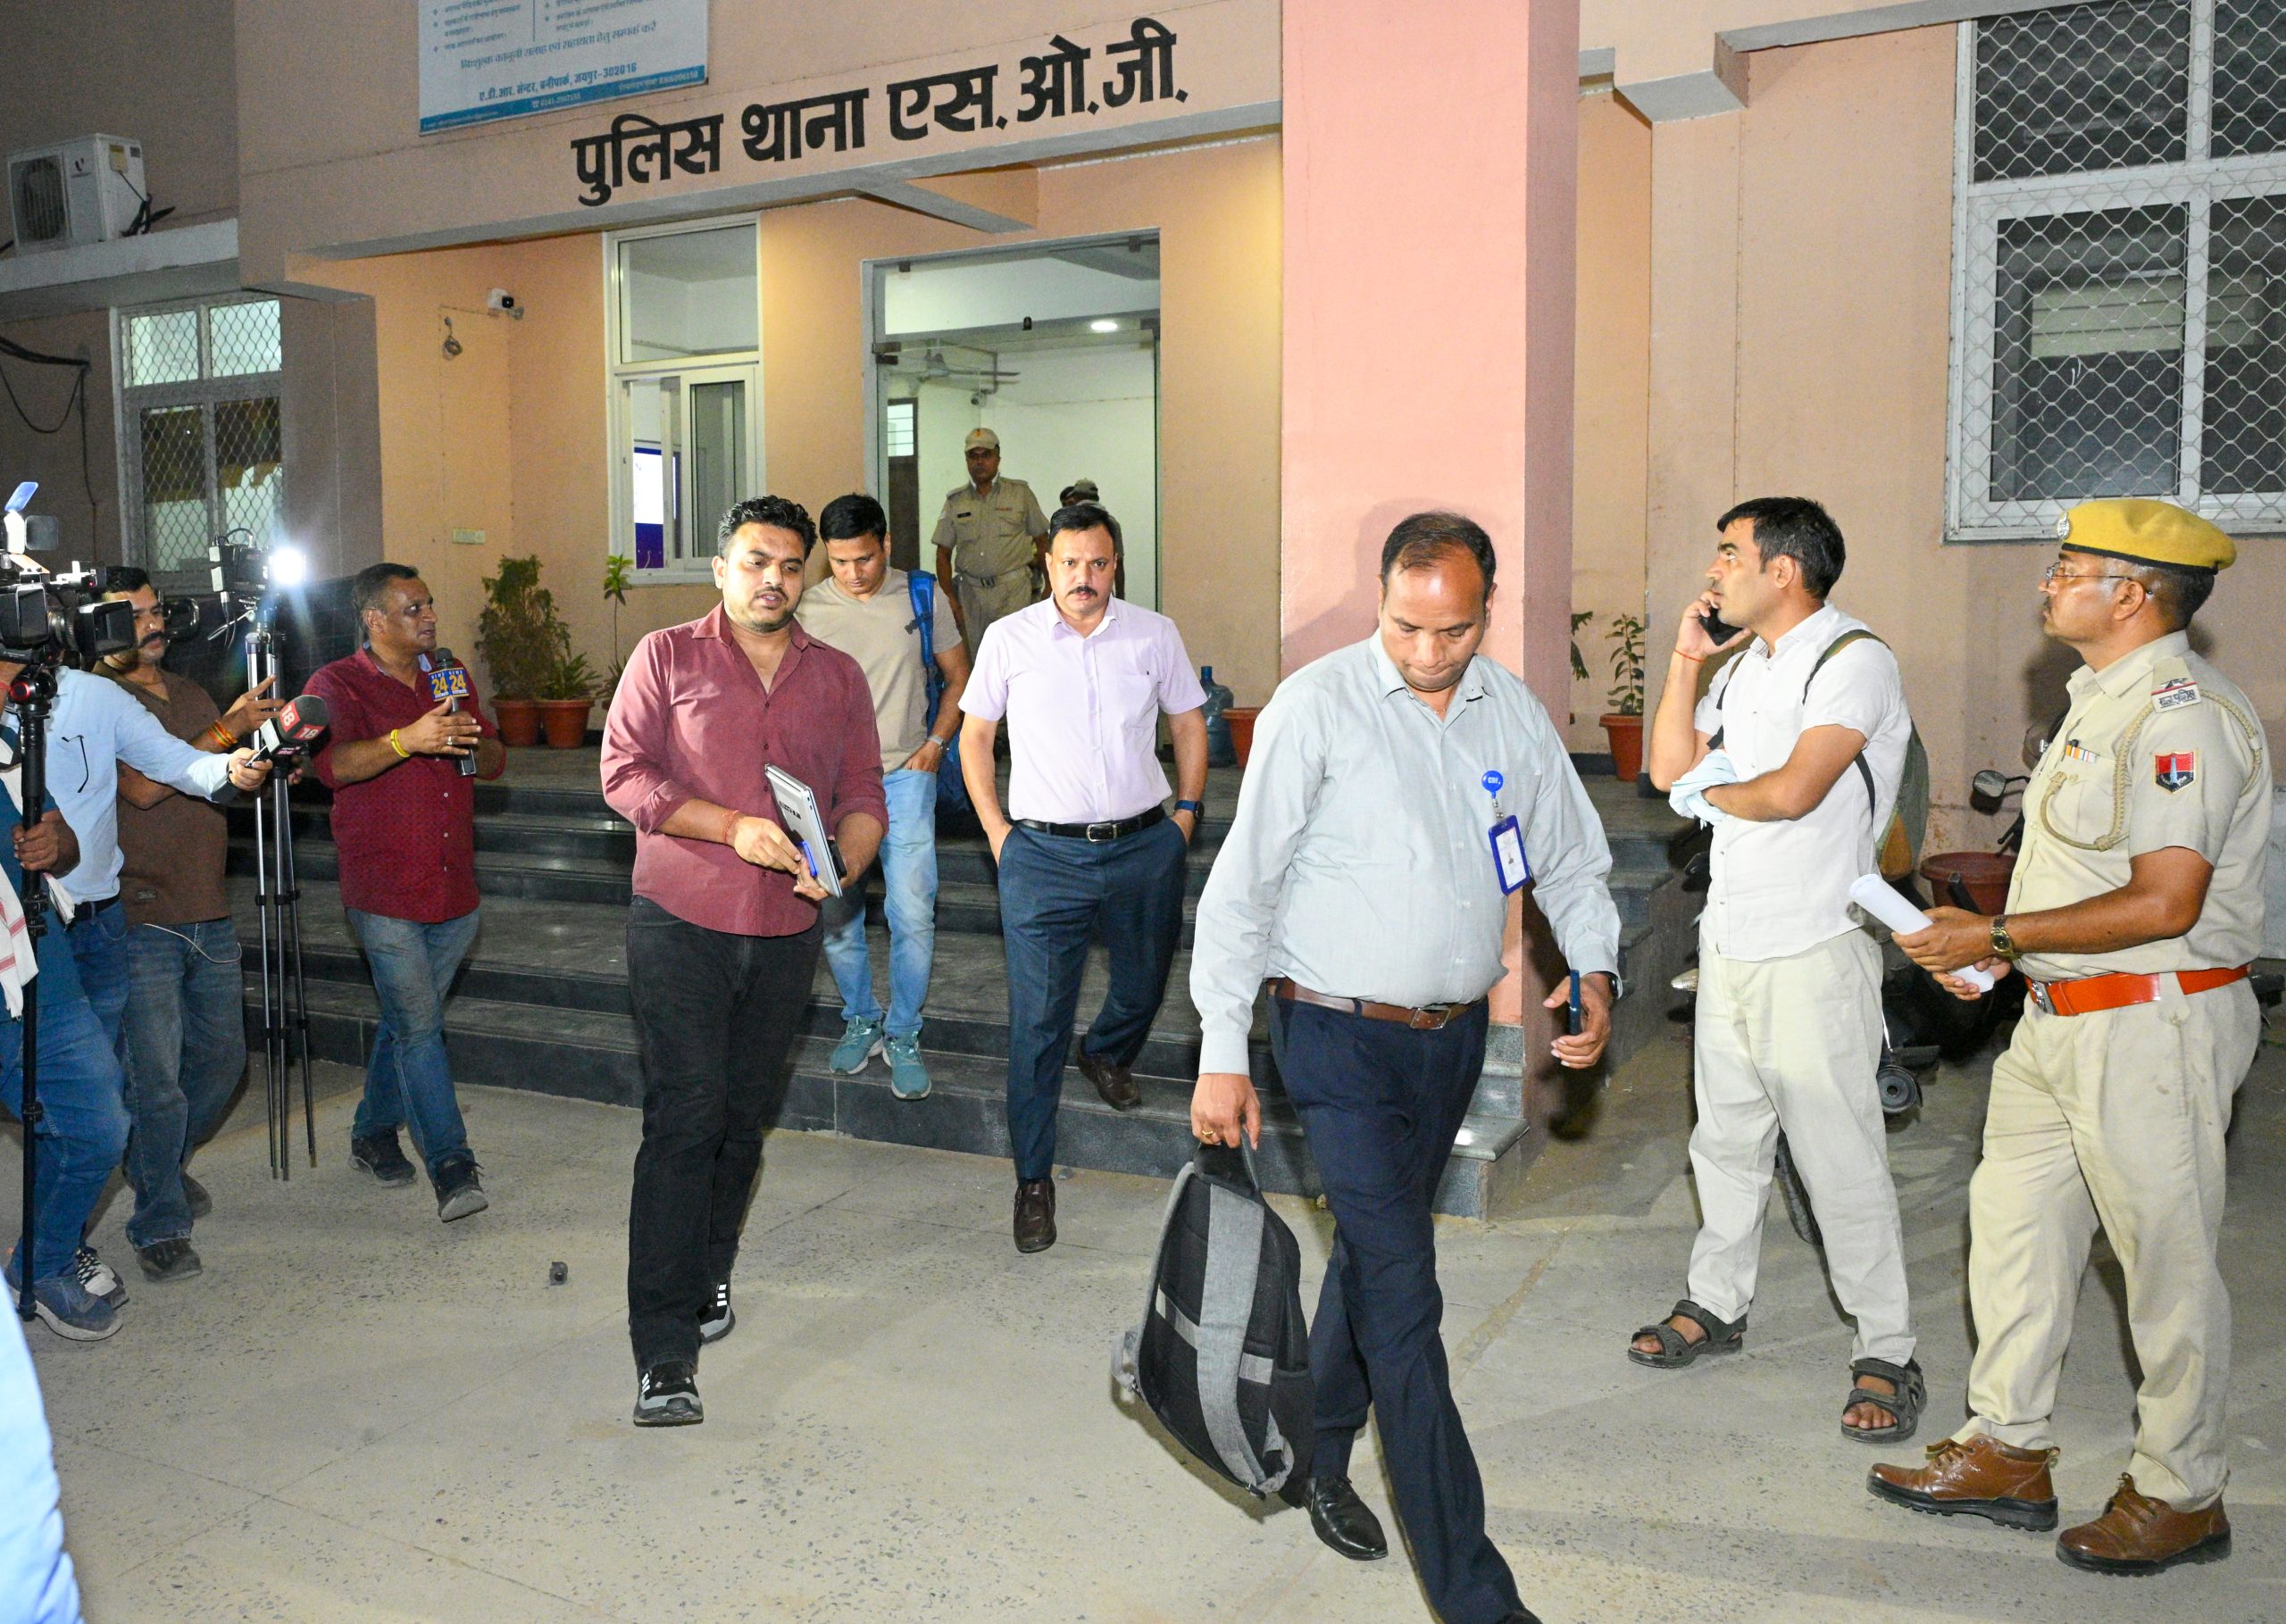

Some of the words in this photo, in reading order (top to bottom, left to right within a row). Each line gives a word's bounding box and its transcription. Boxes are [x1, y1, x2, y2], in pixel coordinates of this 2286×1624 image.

[571, 113, 724, 207] पुलिस
[741, 87, 870, 162] थाना
[432, 676, 447, 695] 24
[449, 674, 466, 691] 24
[281, 704, 296, 727] 18
[299, 727, 319, 739] 18
